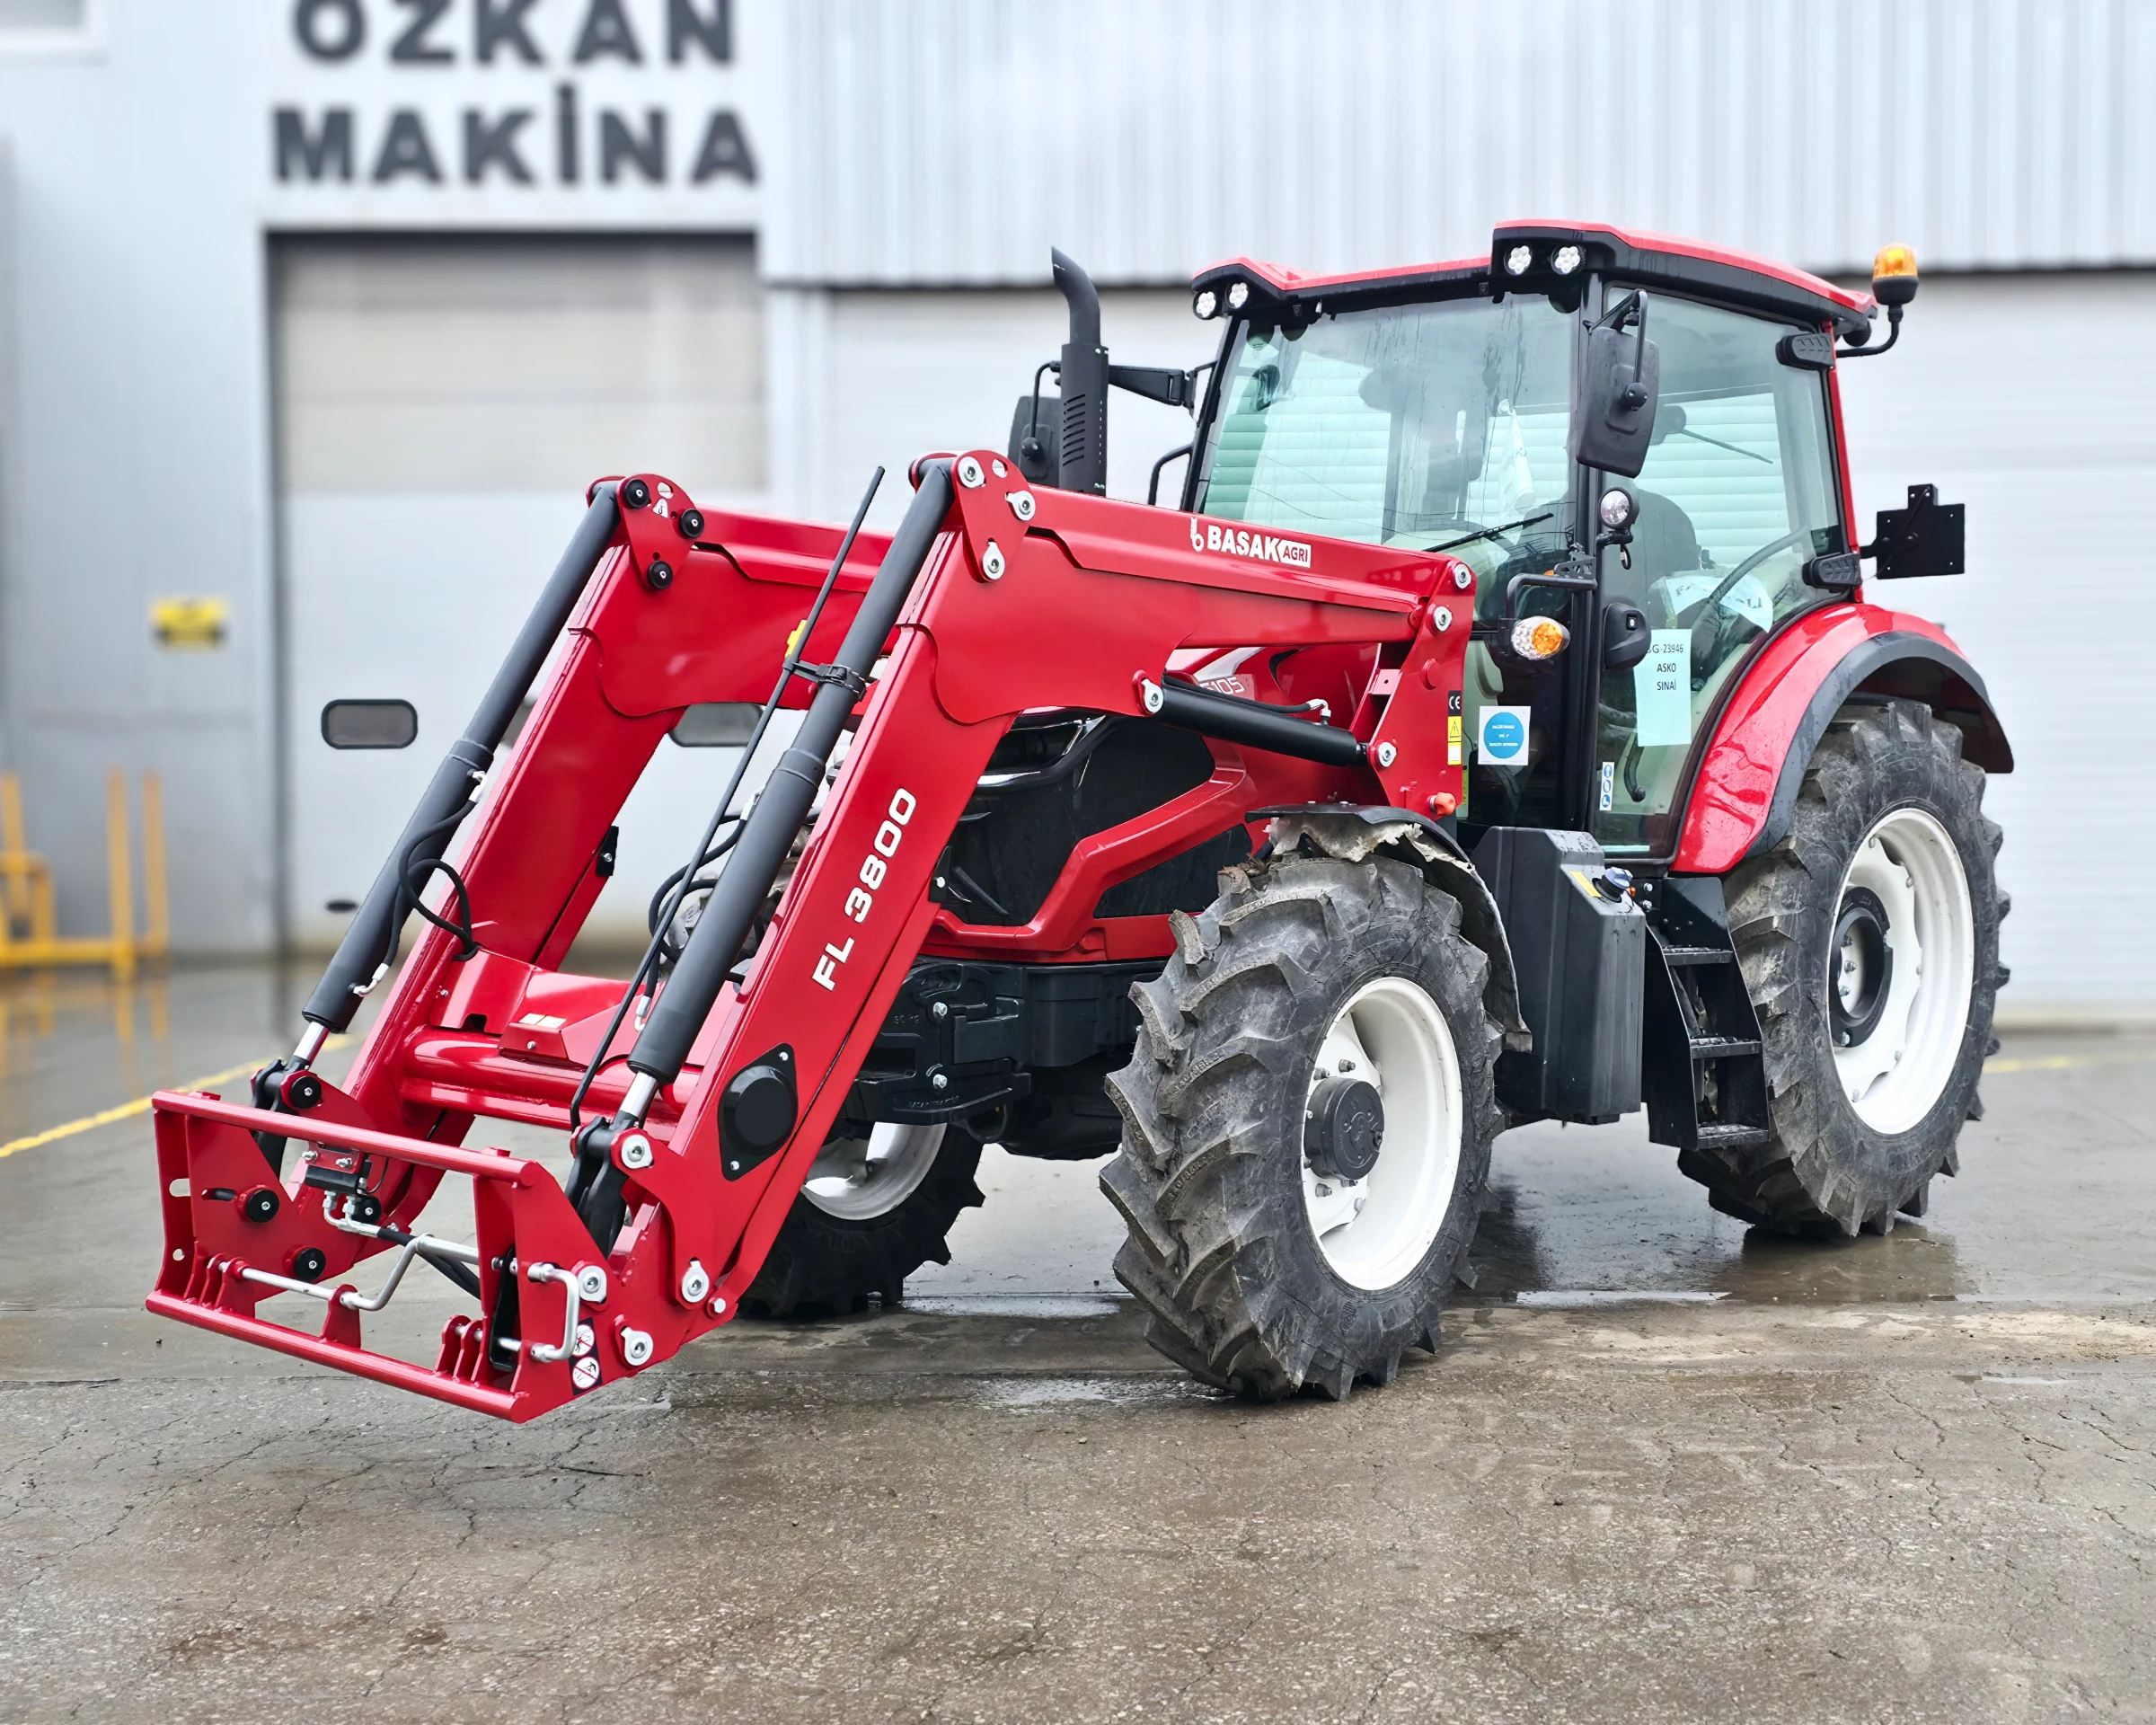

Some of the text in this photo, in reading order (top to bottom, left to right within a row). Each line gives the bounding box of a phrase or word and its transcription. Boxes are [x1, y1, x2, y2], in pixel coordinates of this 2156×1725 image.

[273, 82, 759, 186] MAKİNA
[1283, 544, 1308, 562] AGRI
[1657, 662, 1677, 673] ASKO
[812, 787, 917, 991] FL 3800
